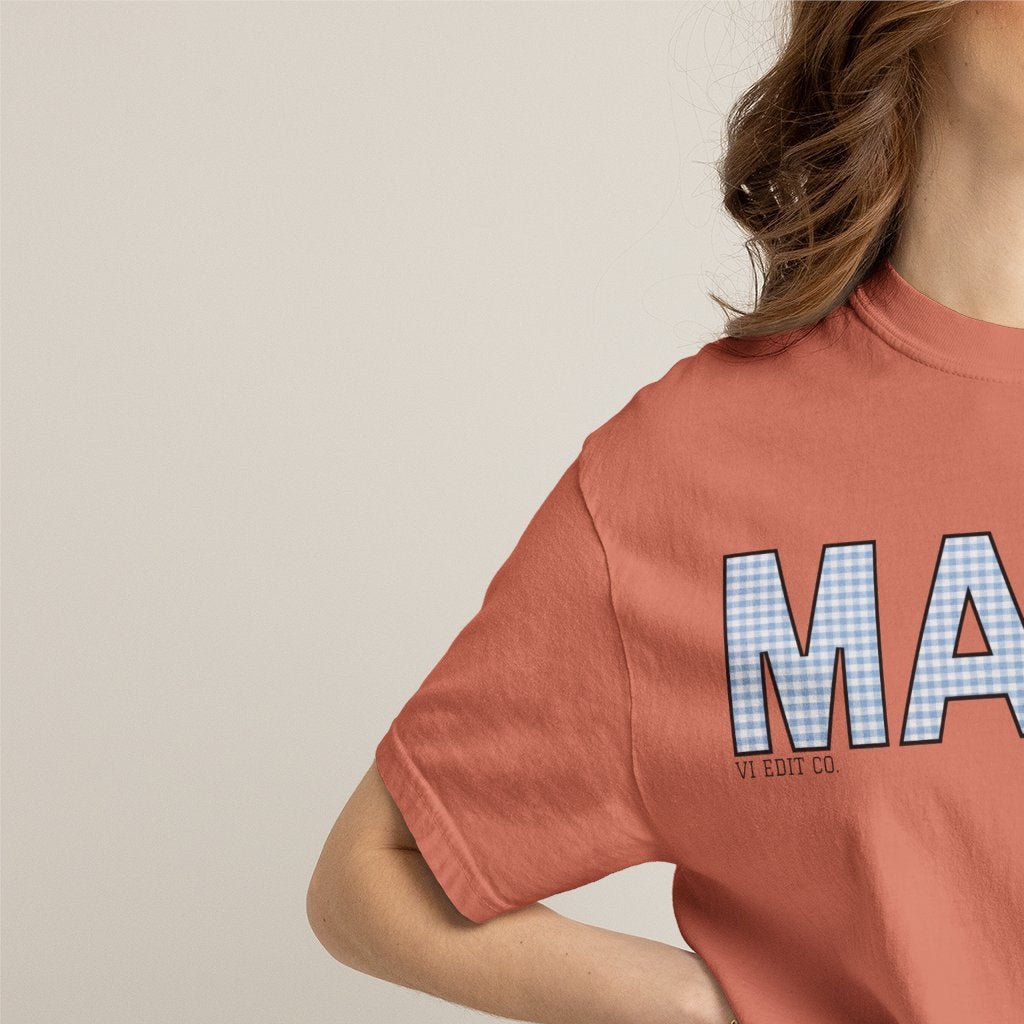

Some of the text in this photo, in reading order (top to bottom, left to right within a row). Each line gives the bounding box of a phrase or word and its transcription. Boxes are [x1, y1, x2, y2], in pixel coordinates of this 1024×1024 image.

[735, 755, 840, 779] VI EDIT CO.
